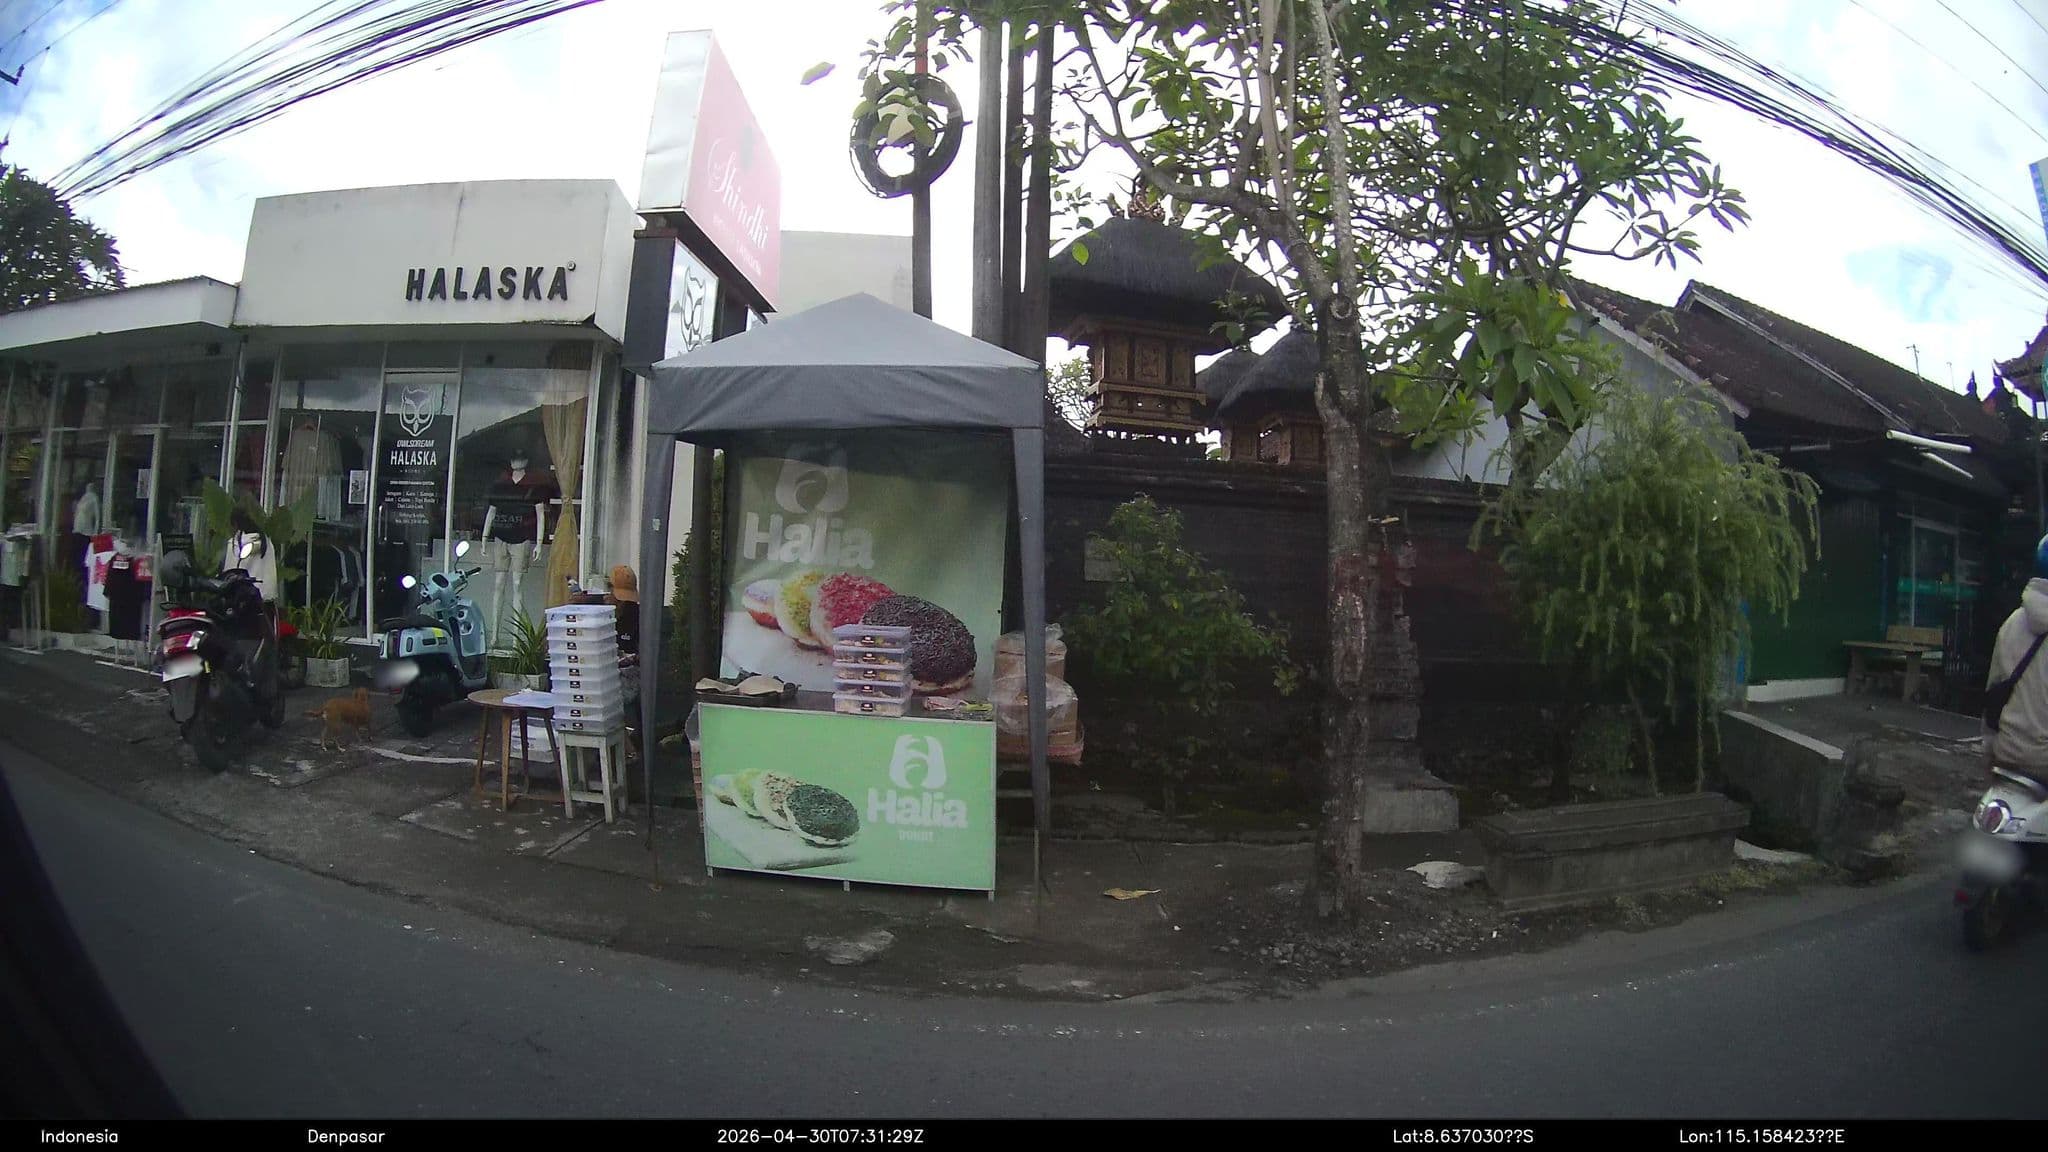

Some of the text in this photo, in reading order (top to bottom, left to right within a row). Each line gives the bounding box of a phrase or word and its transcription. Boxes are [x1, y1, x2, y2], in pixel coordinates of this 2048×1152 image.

[390, 450, 437, 466] HALASKA
[743, 511, 875, 569] Halia
[866, 787, 969, 828] Halia
